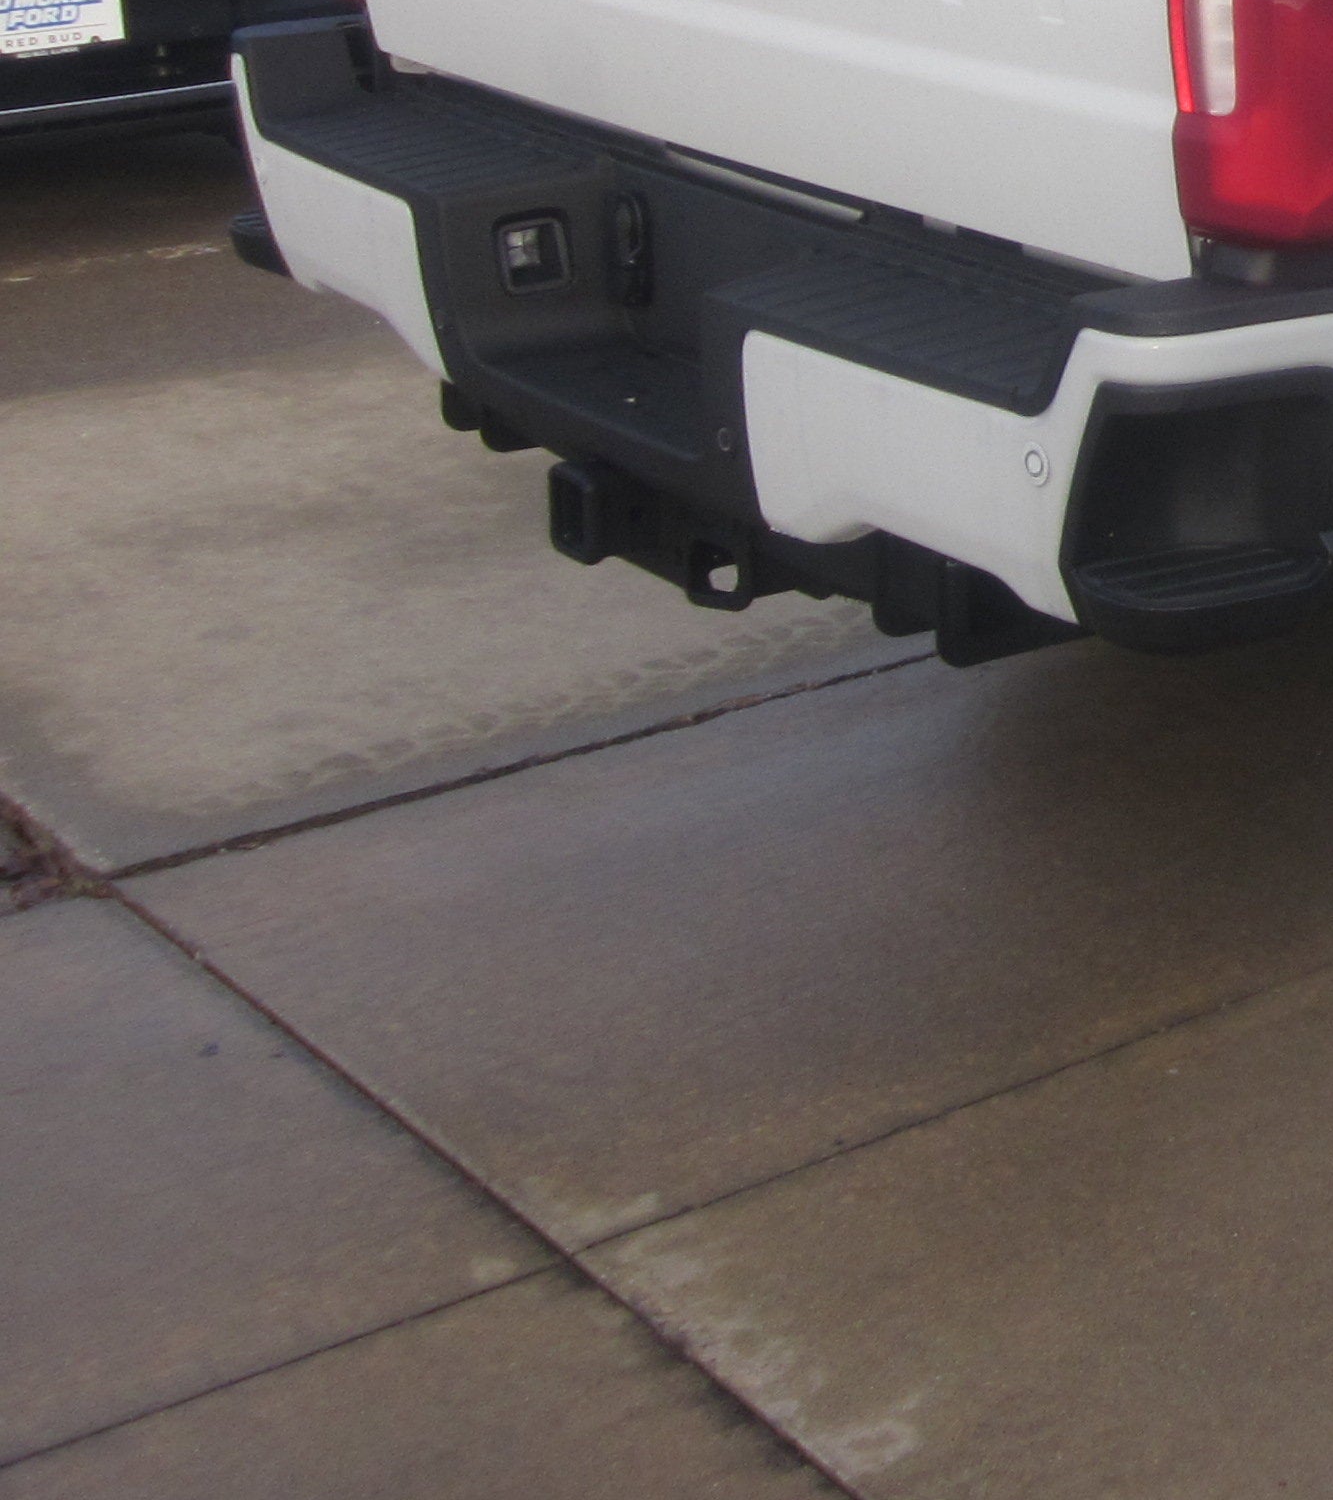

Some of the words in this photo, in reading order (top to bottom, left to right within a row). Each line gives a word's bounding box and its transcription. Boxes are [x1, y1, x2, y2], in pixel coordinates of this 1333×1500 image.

[5, 4, 80, 31] FORD
[5, 35, 39, 49] RED
[47, 31, 82, 45] BUD
